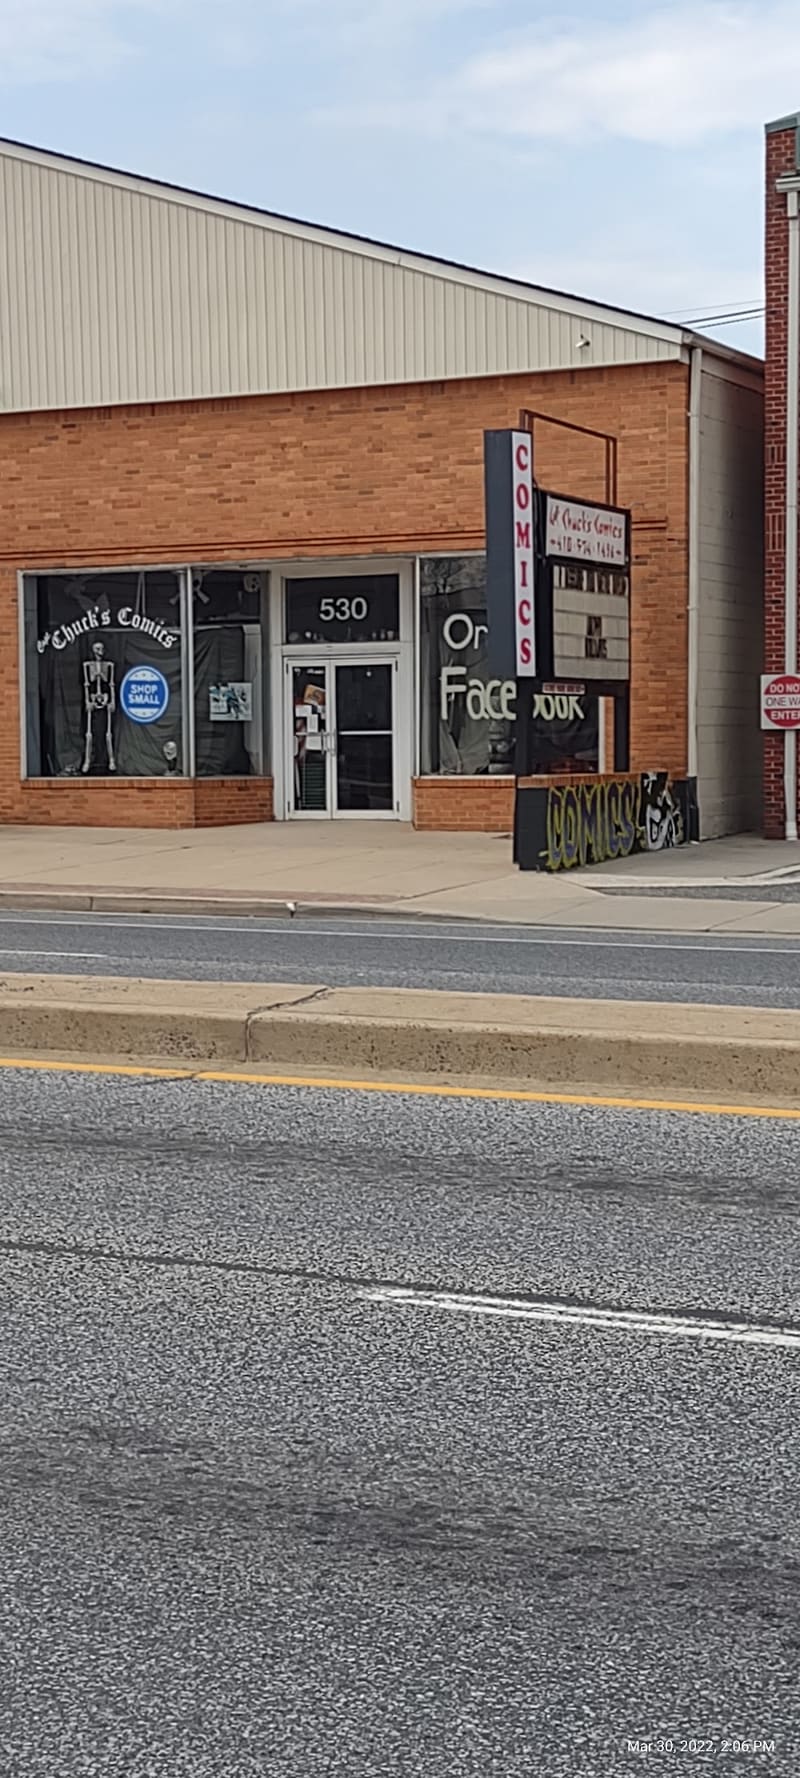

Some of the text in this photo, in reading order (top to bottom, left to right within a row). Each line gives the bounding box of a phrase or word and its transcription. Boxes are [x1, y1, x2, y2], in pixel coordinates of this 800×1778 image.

[594, 514, 623, 539] Comics
[515, 444, 532, 665] COMICS
[319, 597, 368, 621] 530
[51, 606, 111, 649] Chuck's
[117, 607, 177, 648] Comics
[130, 684, 158, 694] SHOP
[769, 683, 784, 693] DO
[128, 694, 160, 705] SMALL
[766, 697, 787, 707] ONE
[771, 710, 800, 720] ENTE
[547, 780, 635, 869] COMICS
